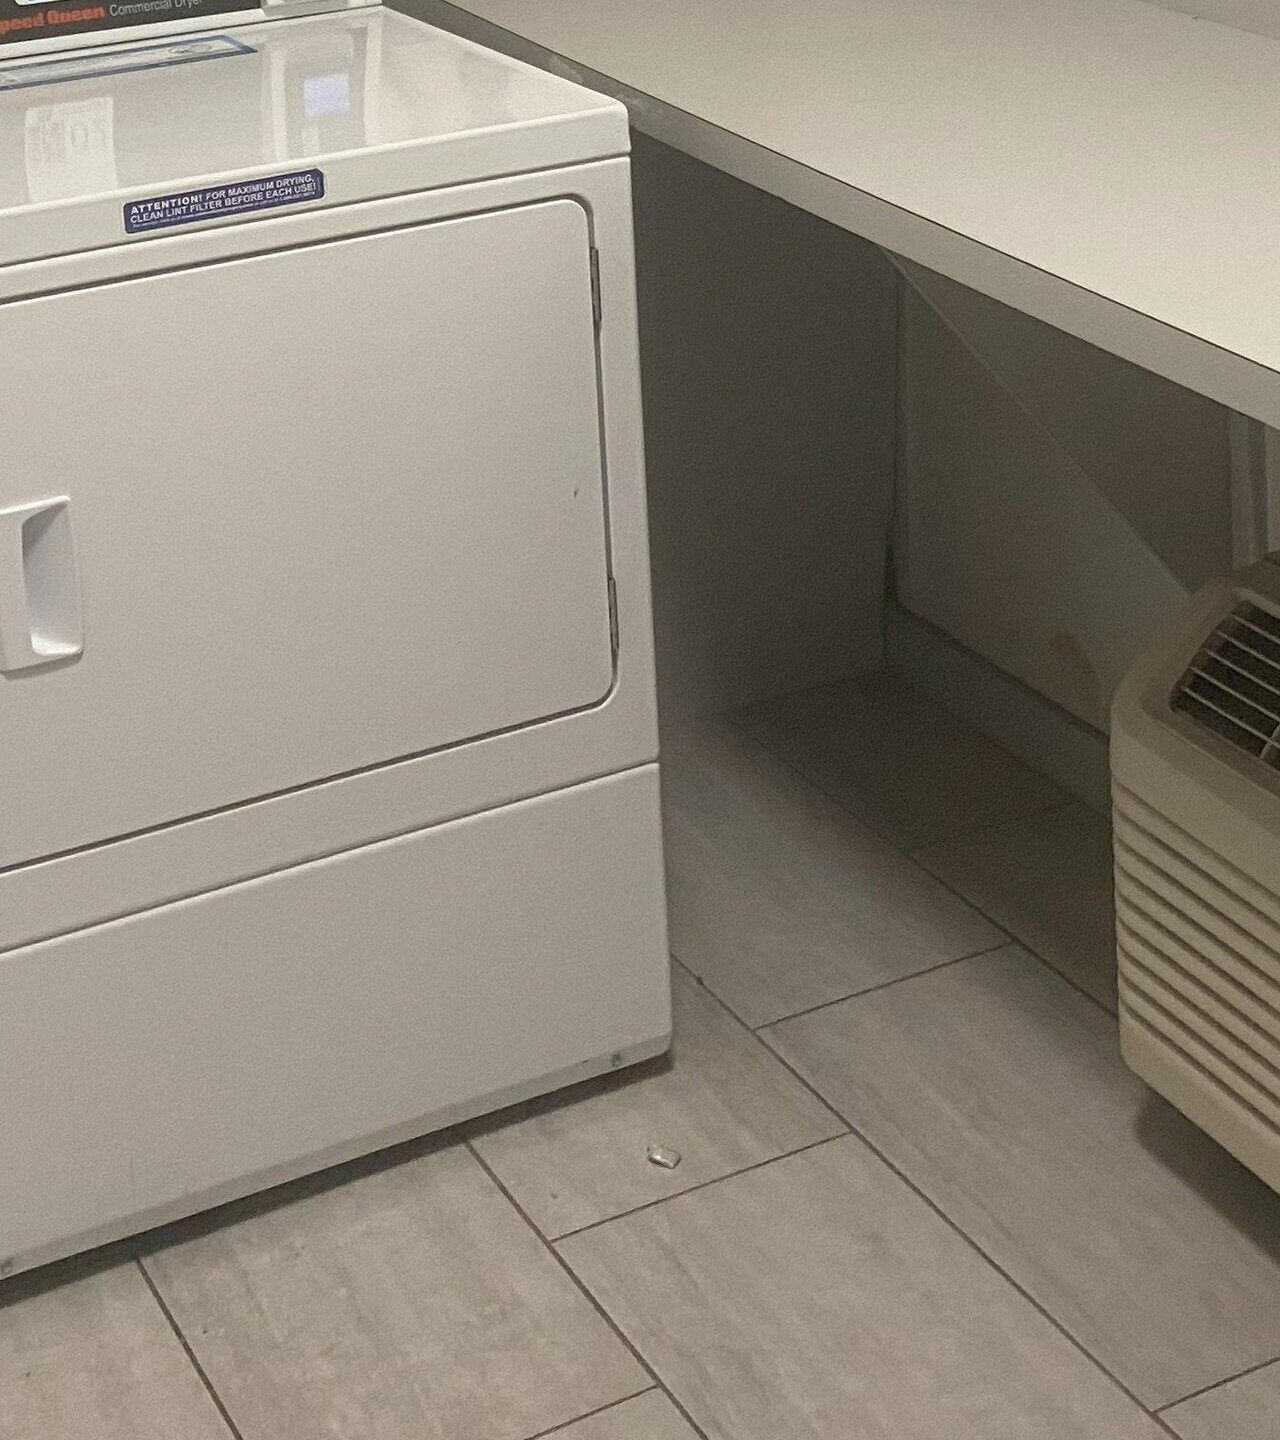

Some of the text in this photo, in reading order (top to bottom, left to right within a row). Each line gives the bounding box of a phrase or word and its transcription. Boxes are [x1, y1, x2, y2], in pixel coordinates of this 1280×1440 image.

[47, 6, 107, 26] Queen
[130, 193, 204, 215] ATTENTION!
[205, 189, 226, 202] FOR
[228, 180, 274, 197] MAXIMUM
[130, 181, 317, 224] CLEAN LINT FILTER BEFORE EACH USE!
